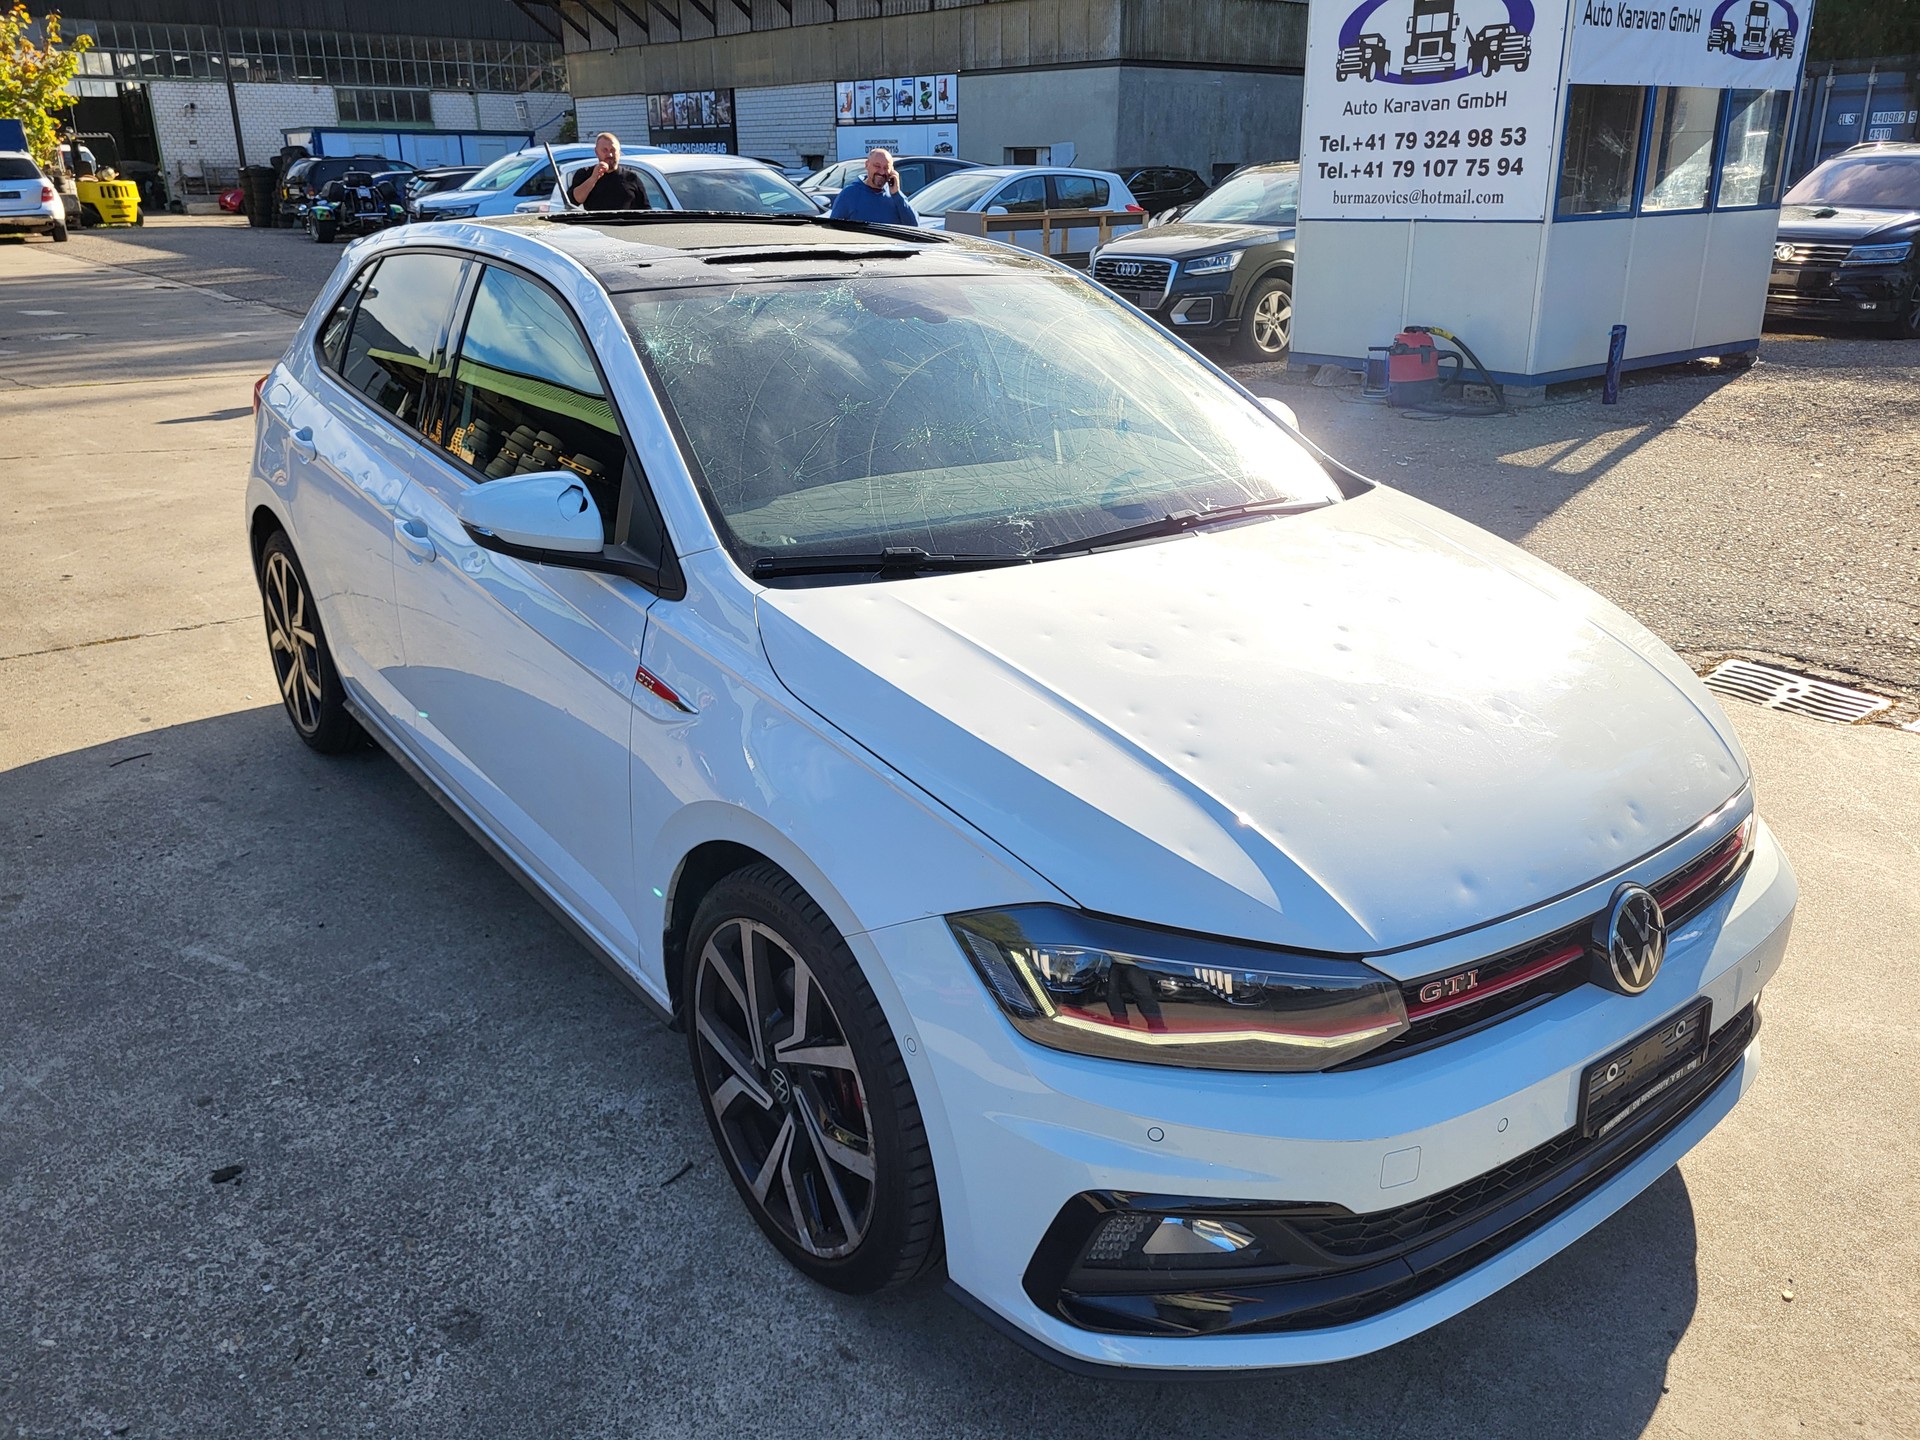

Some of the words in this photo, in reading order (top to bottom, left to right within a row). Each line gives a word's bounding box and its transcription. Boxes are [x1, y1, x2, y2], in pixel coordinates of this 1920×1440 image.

[1583, 0, 1613, 27] Auto
[1617, 2, 1666, 30] Karavan
[1669, 6, 1702, 33] GmbH
[1343, 100, 1378, 116] Auto
[1384, 97, 1450, 114] Karavan
[1457, 91, 1507, 109] GmbH
[1872, 112, 1905, 124] 440982
[1319, 133, 1386, 152] Tel.+41
[1395, 131, 1418, 150] 79
[1424, 130, 1461, 149] 324
[1467, 128, 1493, 148] 98
[1500, 126, 1527, 146] 53
[1869, 129, 1892, 139] 4310
[691, 143, 716, 154] GARAGE
[717, 142, 727, 154] AG
[1317, 161, 1384, 180] Tel.+41
[1392, 160, 1415, 178] 79
[1423, 159, 1458, 178] 107
[1465, 158, 1490, 177] 75
[1497, 157, 1524, 176] 94
[1333, 189, 1504, 205] burmazovics@hotmail.com
[638, 672, 655, 689] GTI
[1419, 968, 1480, 1005] GTI
